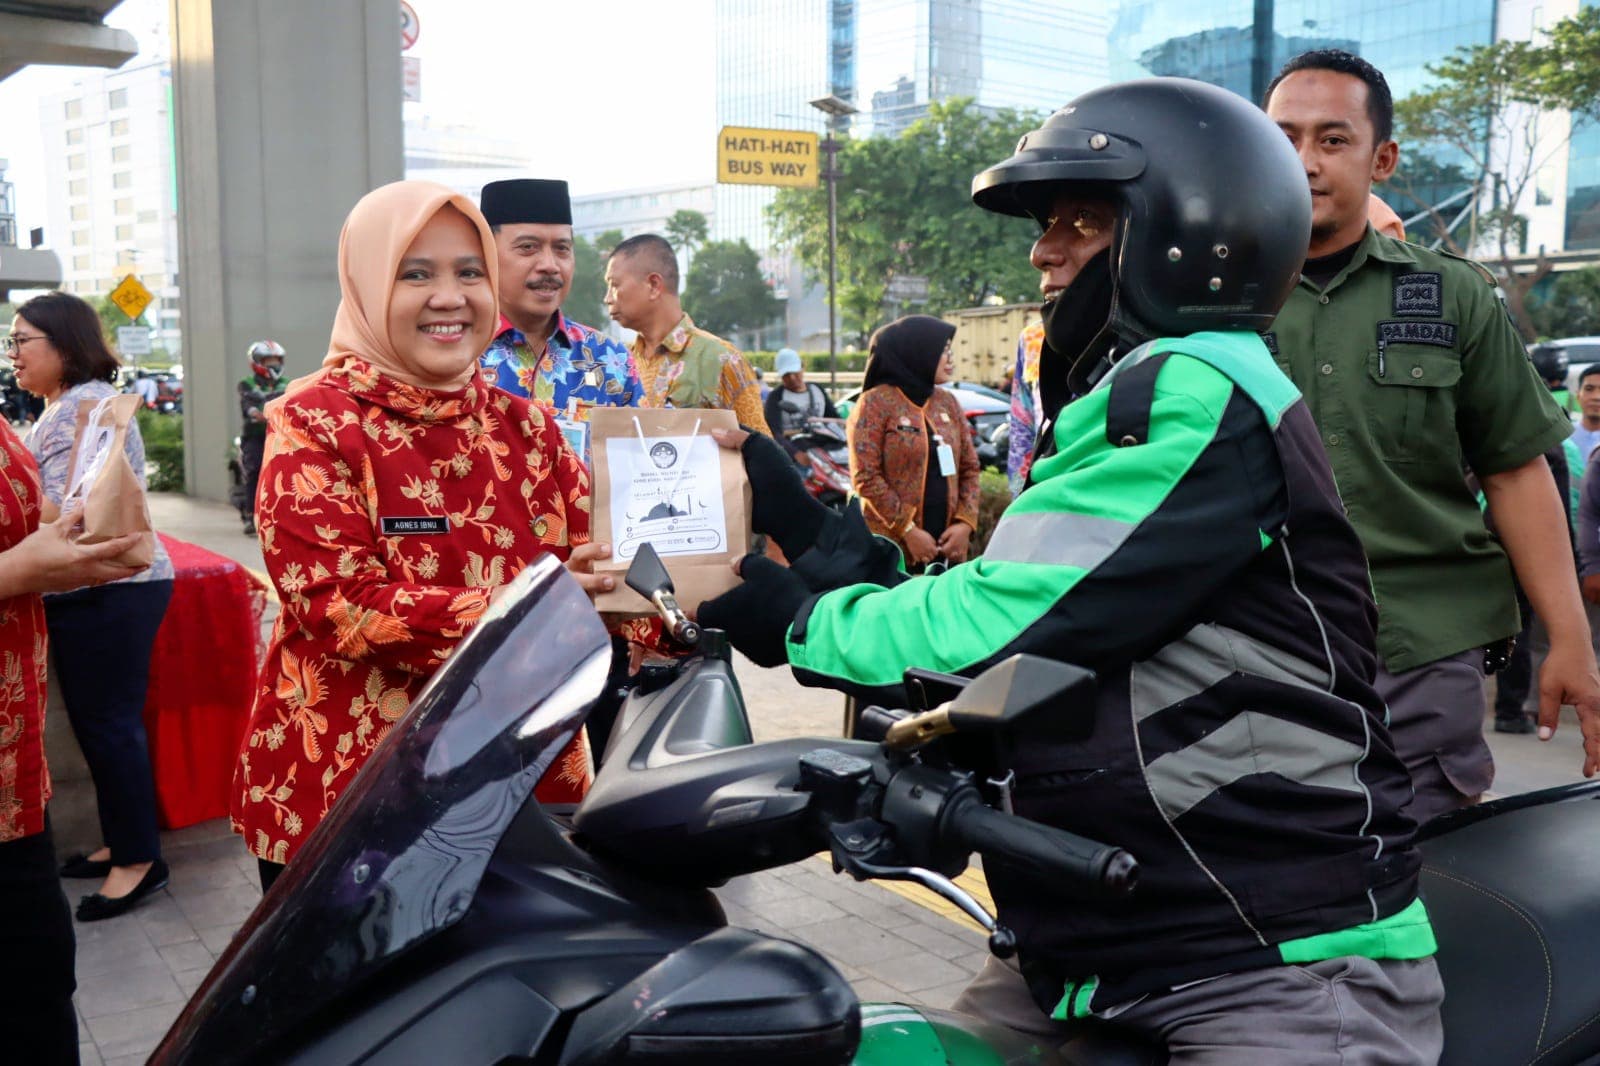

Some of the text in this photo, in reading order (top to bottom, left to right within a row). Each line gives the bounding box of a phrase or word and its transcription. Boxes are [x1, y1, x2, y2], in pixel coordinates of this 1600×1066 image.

[725, 136, 810, 155] HATI-HATI
[728, 159, 807, 177] BUS WAY
[394, 520, 437, 529] AGNES IBNU
